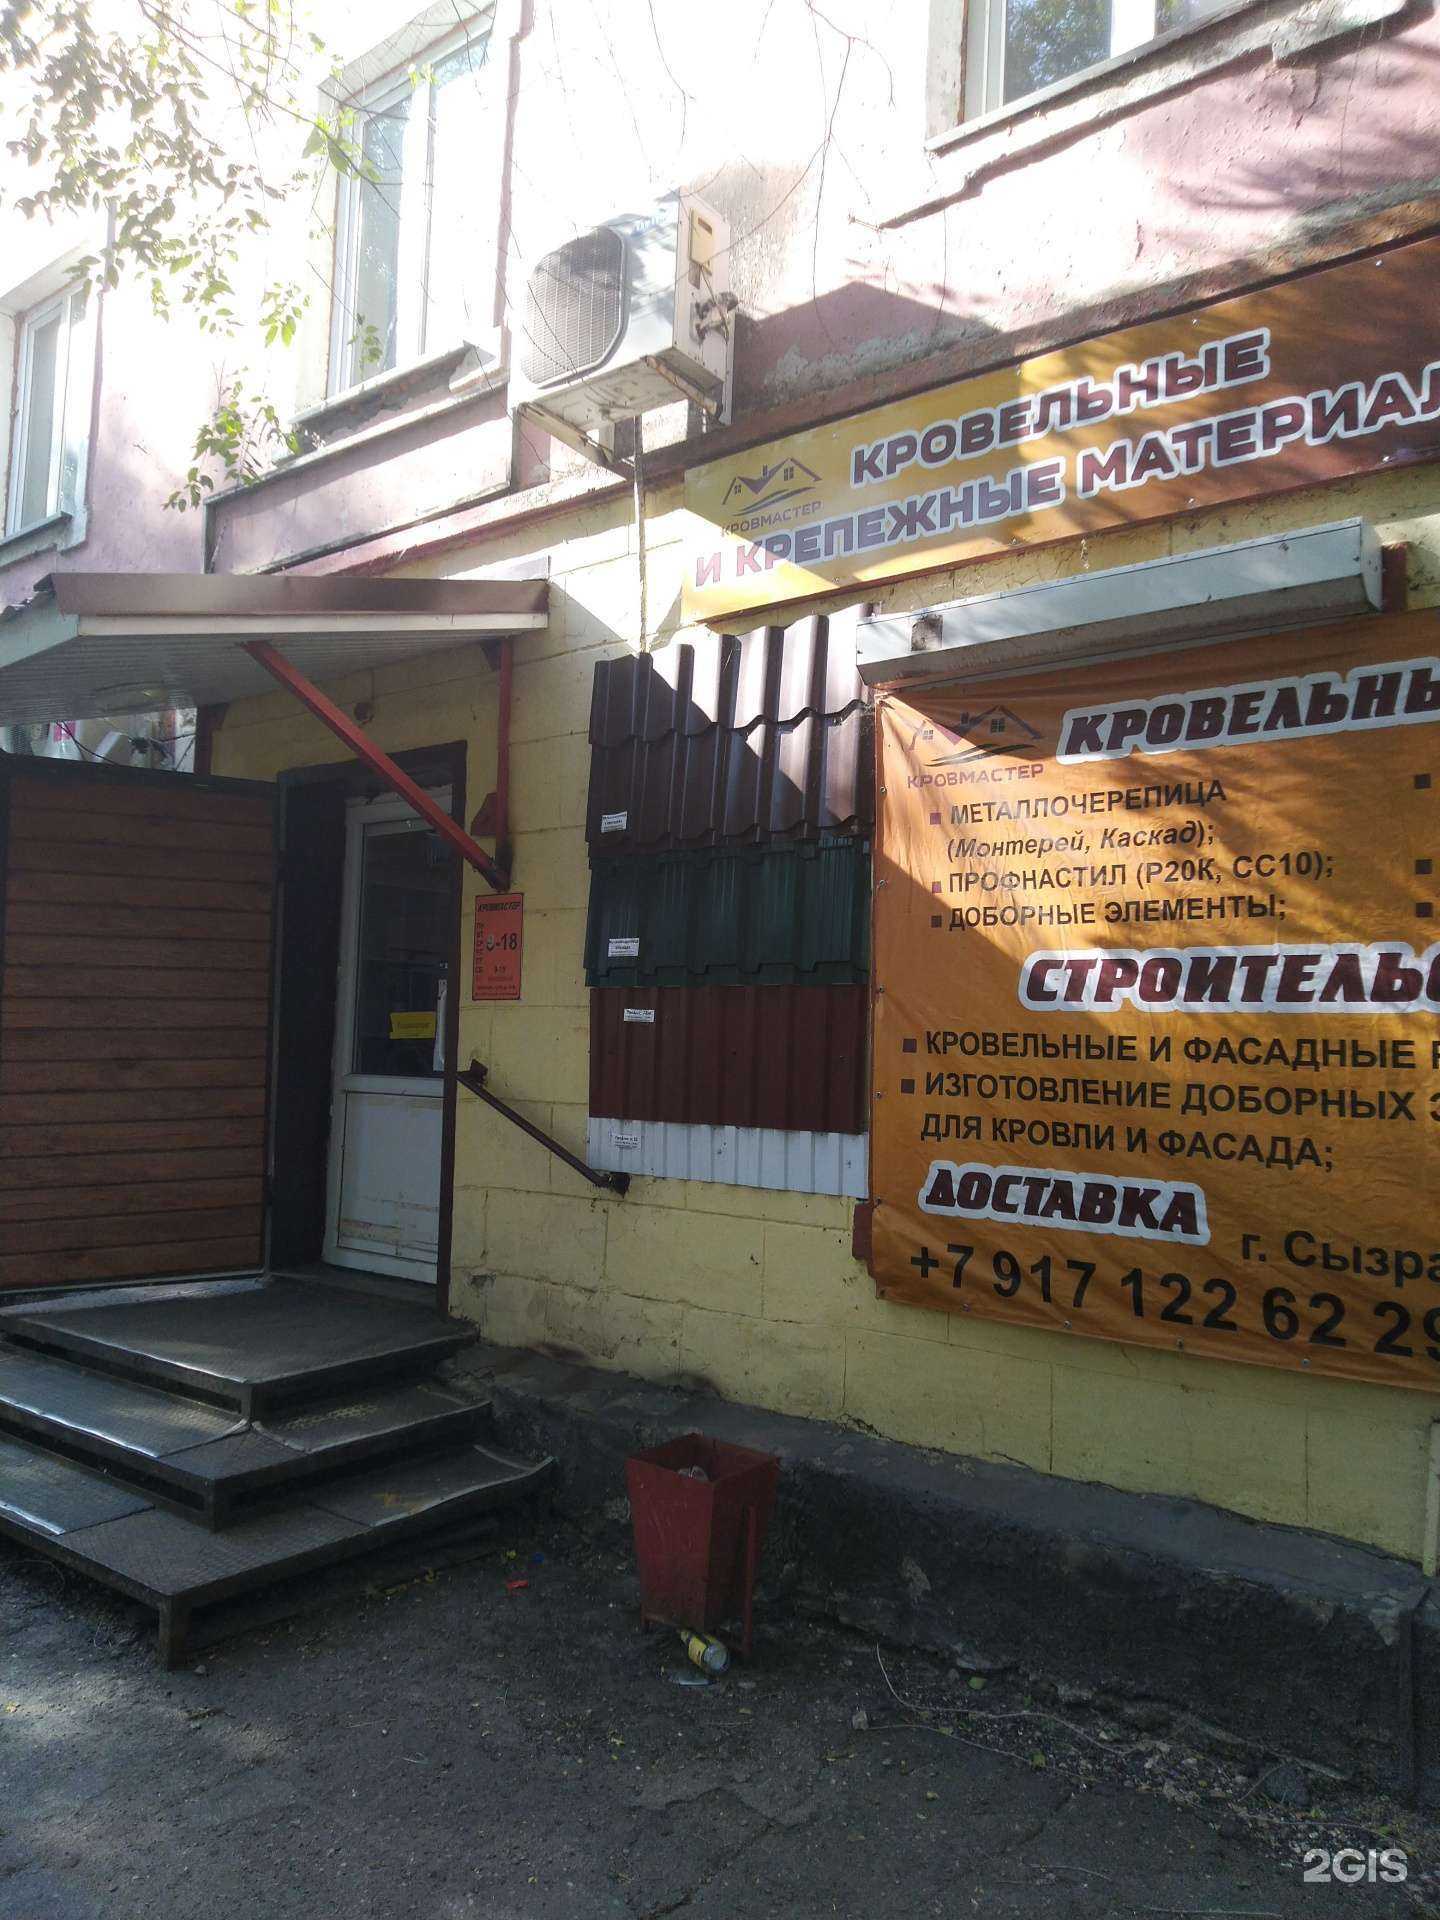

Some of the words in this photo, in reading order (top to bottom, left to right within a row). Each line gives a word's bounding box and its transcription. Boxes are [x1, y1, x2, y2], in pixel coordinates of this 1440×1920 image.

[852, 331, 1267, 487] КРОВЕЛЬНЫЕ
[695, 551, 722, 587] И
[735, 462, 1062, 577] КРЕПЕЖНЫЕ
[720, 500, 823, 537] КРОВМАСТЕР
[907, 763, 1045, 789] КРОВМАСТЕР
[950, 779, 1228, 825] МЕТАЛЛОЧЕРЕПИЦА
[947, 828, 1092, 862] (Монтерей,
[1099, 819, 1215, 850] Каскад);
[949, 863, 1127, 893] ПРОФНАСТИЛ
[949, 903, 1096, 931] ДОБОРНЫЕ
[1104, 895, 1286, 923] ЭЛЕМЕНТЫ;
[926, 1031, 1138, 1061] КРОВЕЛЬНЫЕ
[1149, 1036, 1172, 1063] И
[1183, 1036, 1416, 1072] ФАСАДНЫЕ
[925, 1071, 1172, 1109] ИЗГОТОВЛЕНИЕ
[1180, 1083, 1416, 1121] ДОБОРНЫХ
[920, 1113, 982, 1142] ДЛЯ
[991, 1118, 1115, 1151] КРОВЛИ
[1126, 1126, 1148, 1154] И
[1157, 1129, 1333, 1173] ФАСАДА;
[924, 1167, 1201, 1236] ДОСТАВКА
[1241, 1233, 1268, 1262] г.
[910, 1243, 975, 1289] +7
[992, 1250, 1097, 1308] 917
[1120, 1267, 1238, 1332] 122
[1261, 1286, 1348, 1348] 62
